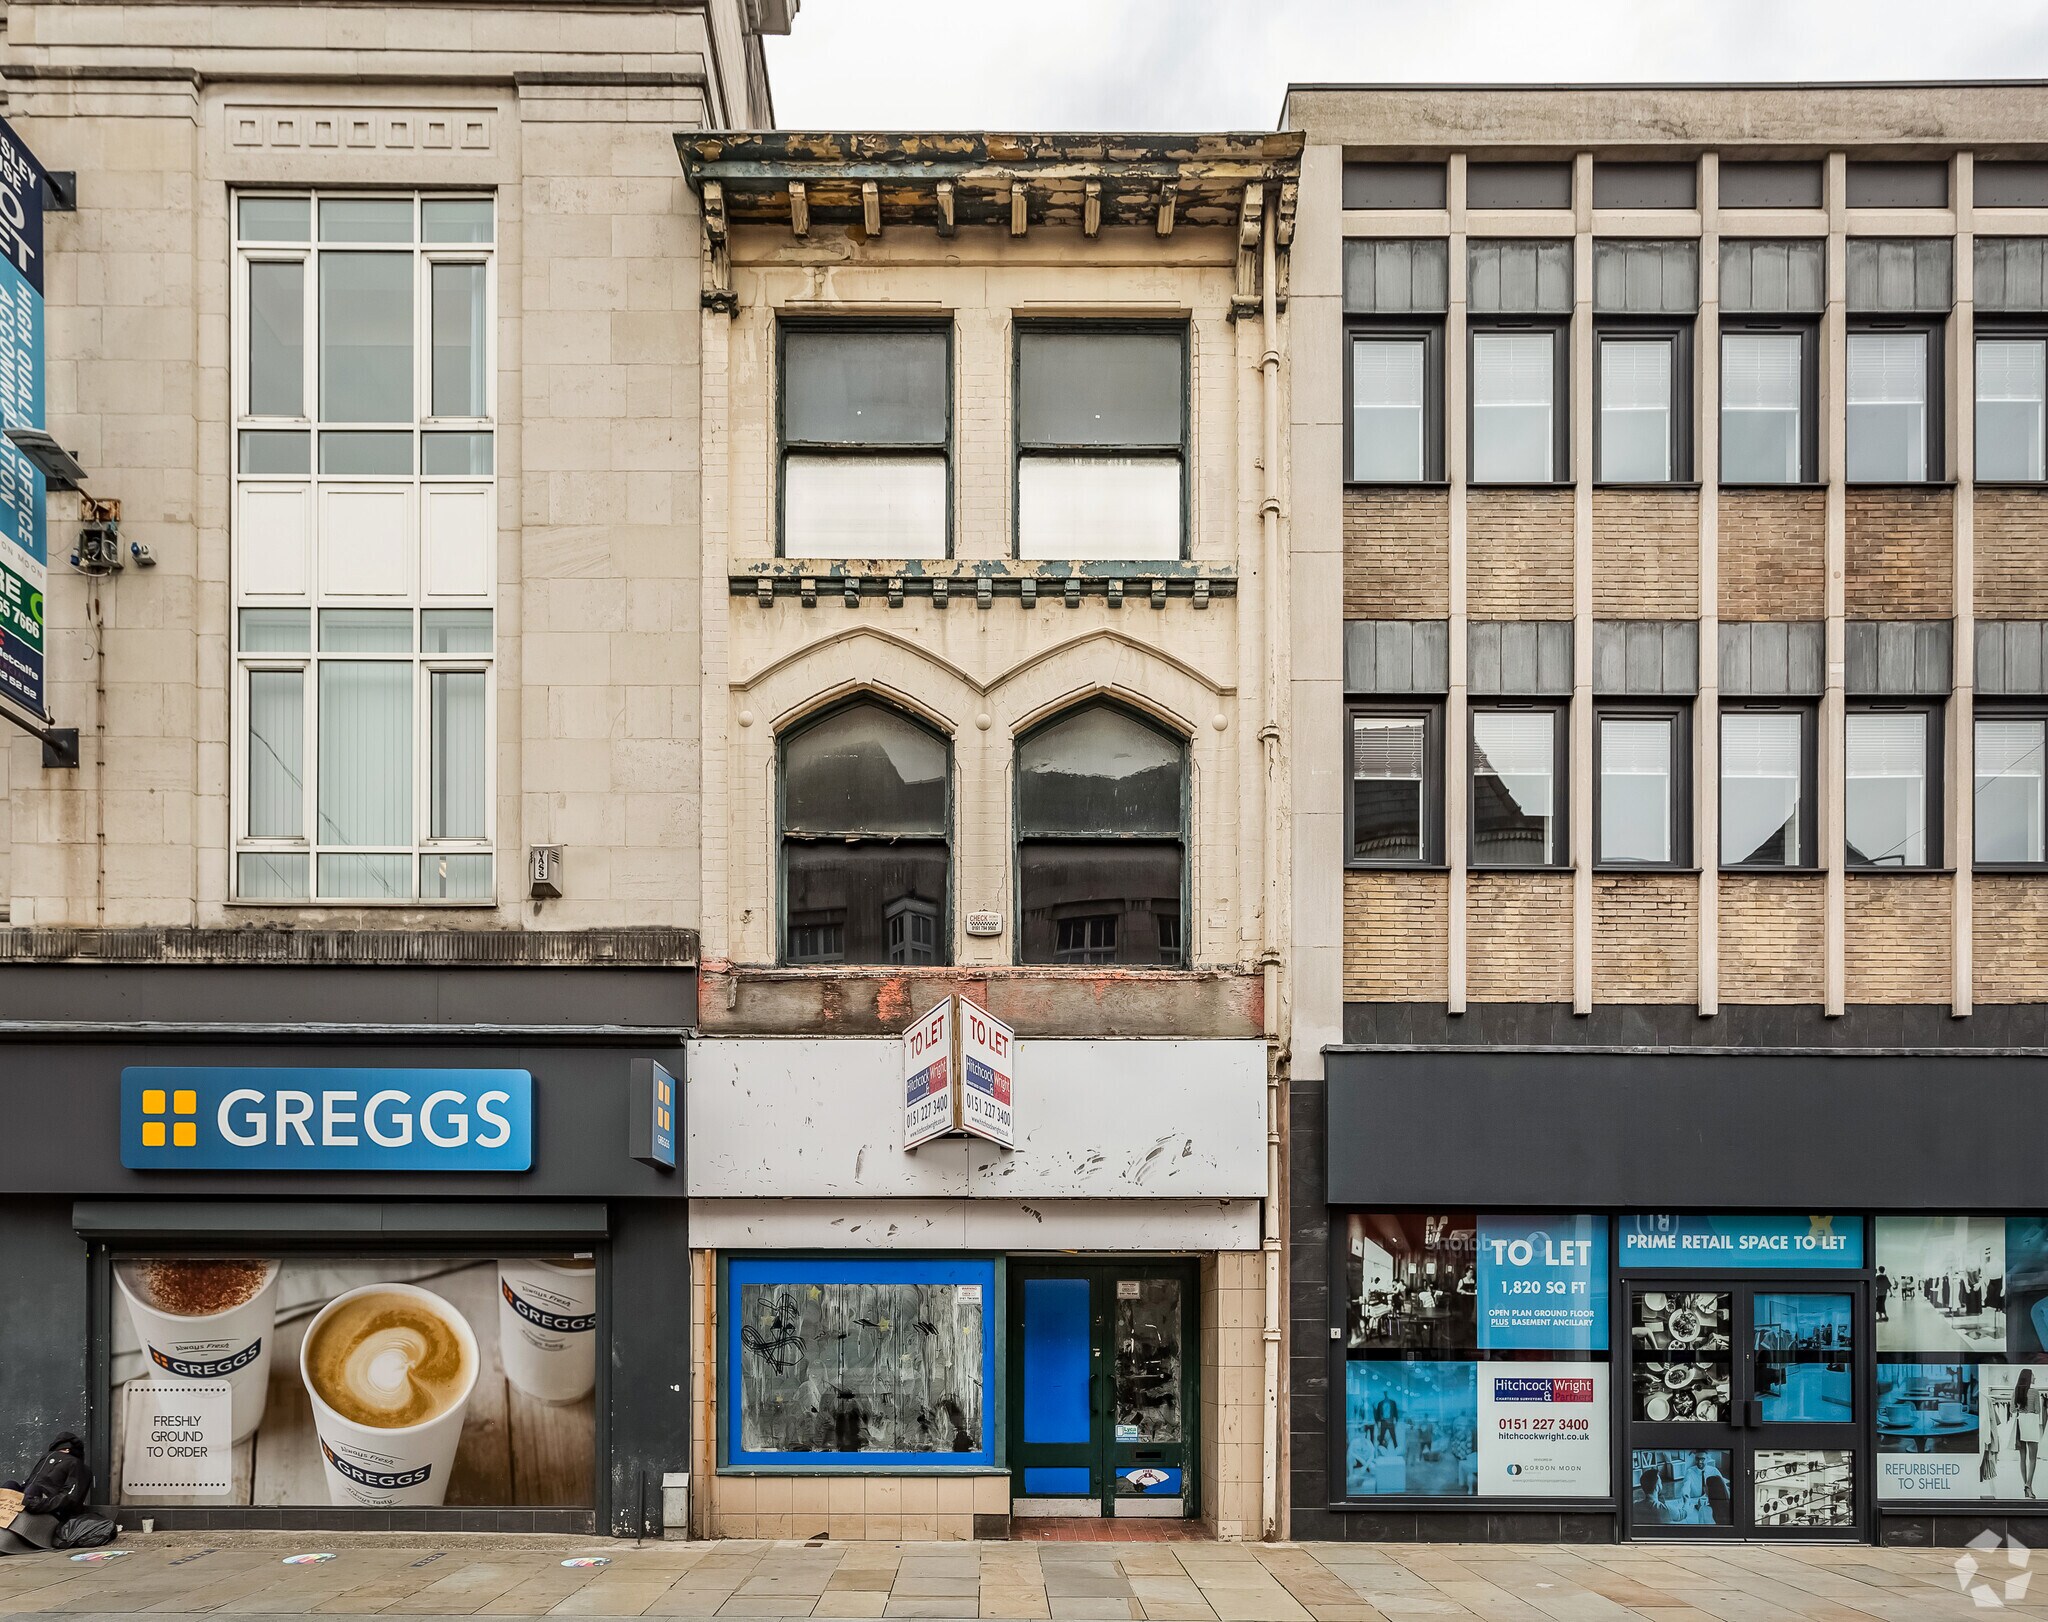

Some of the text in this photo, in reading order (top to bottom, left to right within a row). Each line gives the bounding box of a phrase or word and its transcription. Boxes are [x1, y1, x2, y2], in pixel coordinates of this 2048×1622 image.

[0, 133, 37, 190] SLEY
[16, 280, 33, 350] HIGH
[18, 457, 34, 549] OFFICE
[910, 1014, 945, 1060] TO LET
[969, 1014, 1009, 1059] TO LET
[930, 1061, 947, 1080] Wright
[966, 1058, 994, 1084] Hitchcock
[994, 1072, 1010, 1093] Wright
[217, 1088, 511, 1148] GREGGS
[906, 1108, 920, 1129] 0151
[921, 1102, 932, 1122] 227
[933, 1094, 948, 1115] 3400
[966, 1093, 982, 1114] 0151
[984, 1101, 996, 1119] 227
[997, 1108, 1011, 1127] 3400
[1627, 1234, 1847, 1250] PRIME RETAIL SPACE TO LET
[1491, 1239, 1592, 1266] TO LET
[1502, 1280, 1586, 1296] 1,820 SQ FT
[515, 1300, 596, 1330] GREGGS
[1488, 1309, 1595, 1317] OPEN PLAN GROUND FLOOR
[1491, 1318, 1594, 1327] PLUS BASEMENT ANCILLARY
[172, 1345, 257, 1375] GREGGS
[1496, 1379, 1591, 1394] Hitchcock Wright
[1544, 1391, 1552, 1402] &
[153, 1415, 202, 1427] FRESHLY
[1498, 1418, 1589, 1430] 0151 227 3400
[151, 1430, 204, 1442] GROUND
[1498, 1432, 1590, 1442] hitchcockwright.co.uk
[146, 1446, 208, 1458] TO ORDER
[337, 1460, 426, 1486] GREGGS
[1885, 1463, 1960, 1475] REFURBISHED
[1898, 1477, 1951, 1490] TO SHELL
